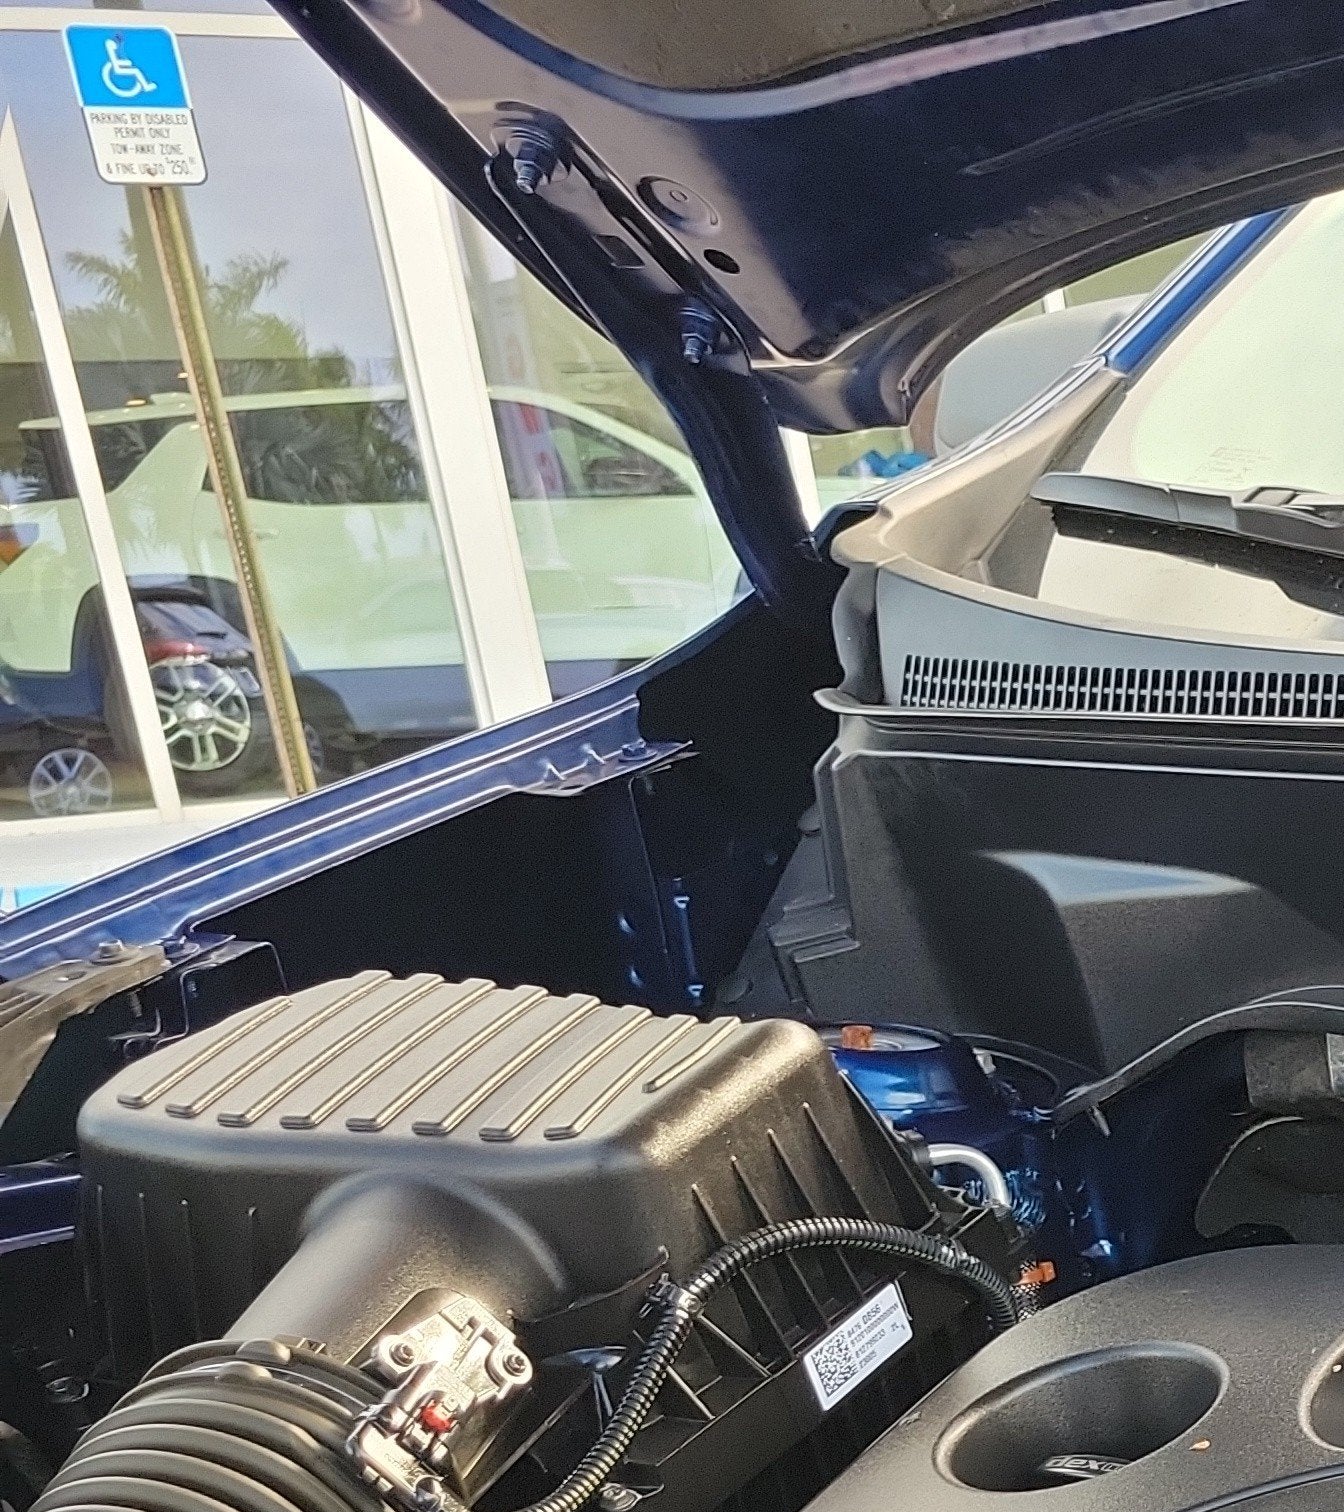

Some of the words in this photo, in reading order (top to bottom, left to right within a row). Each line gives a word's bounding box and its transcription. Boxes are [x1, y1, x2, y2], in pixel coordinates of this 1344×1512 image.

[90, 113, 128, 125] PARKING
[132, 114, 142, 125] BY
[146, 114, 188, 125] DISABLED
[114, 127, 145, 139] PERMIT
[150, 128, 171, 139] ONLY
[111, 143, 155, 155] TOW-AWAY
[160, 143, 184, 155] ZONE
[116, 163, 135, 175] FINE
